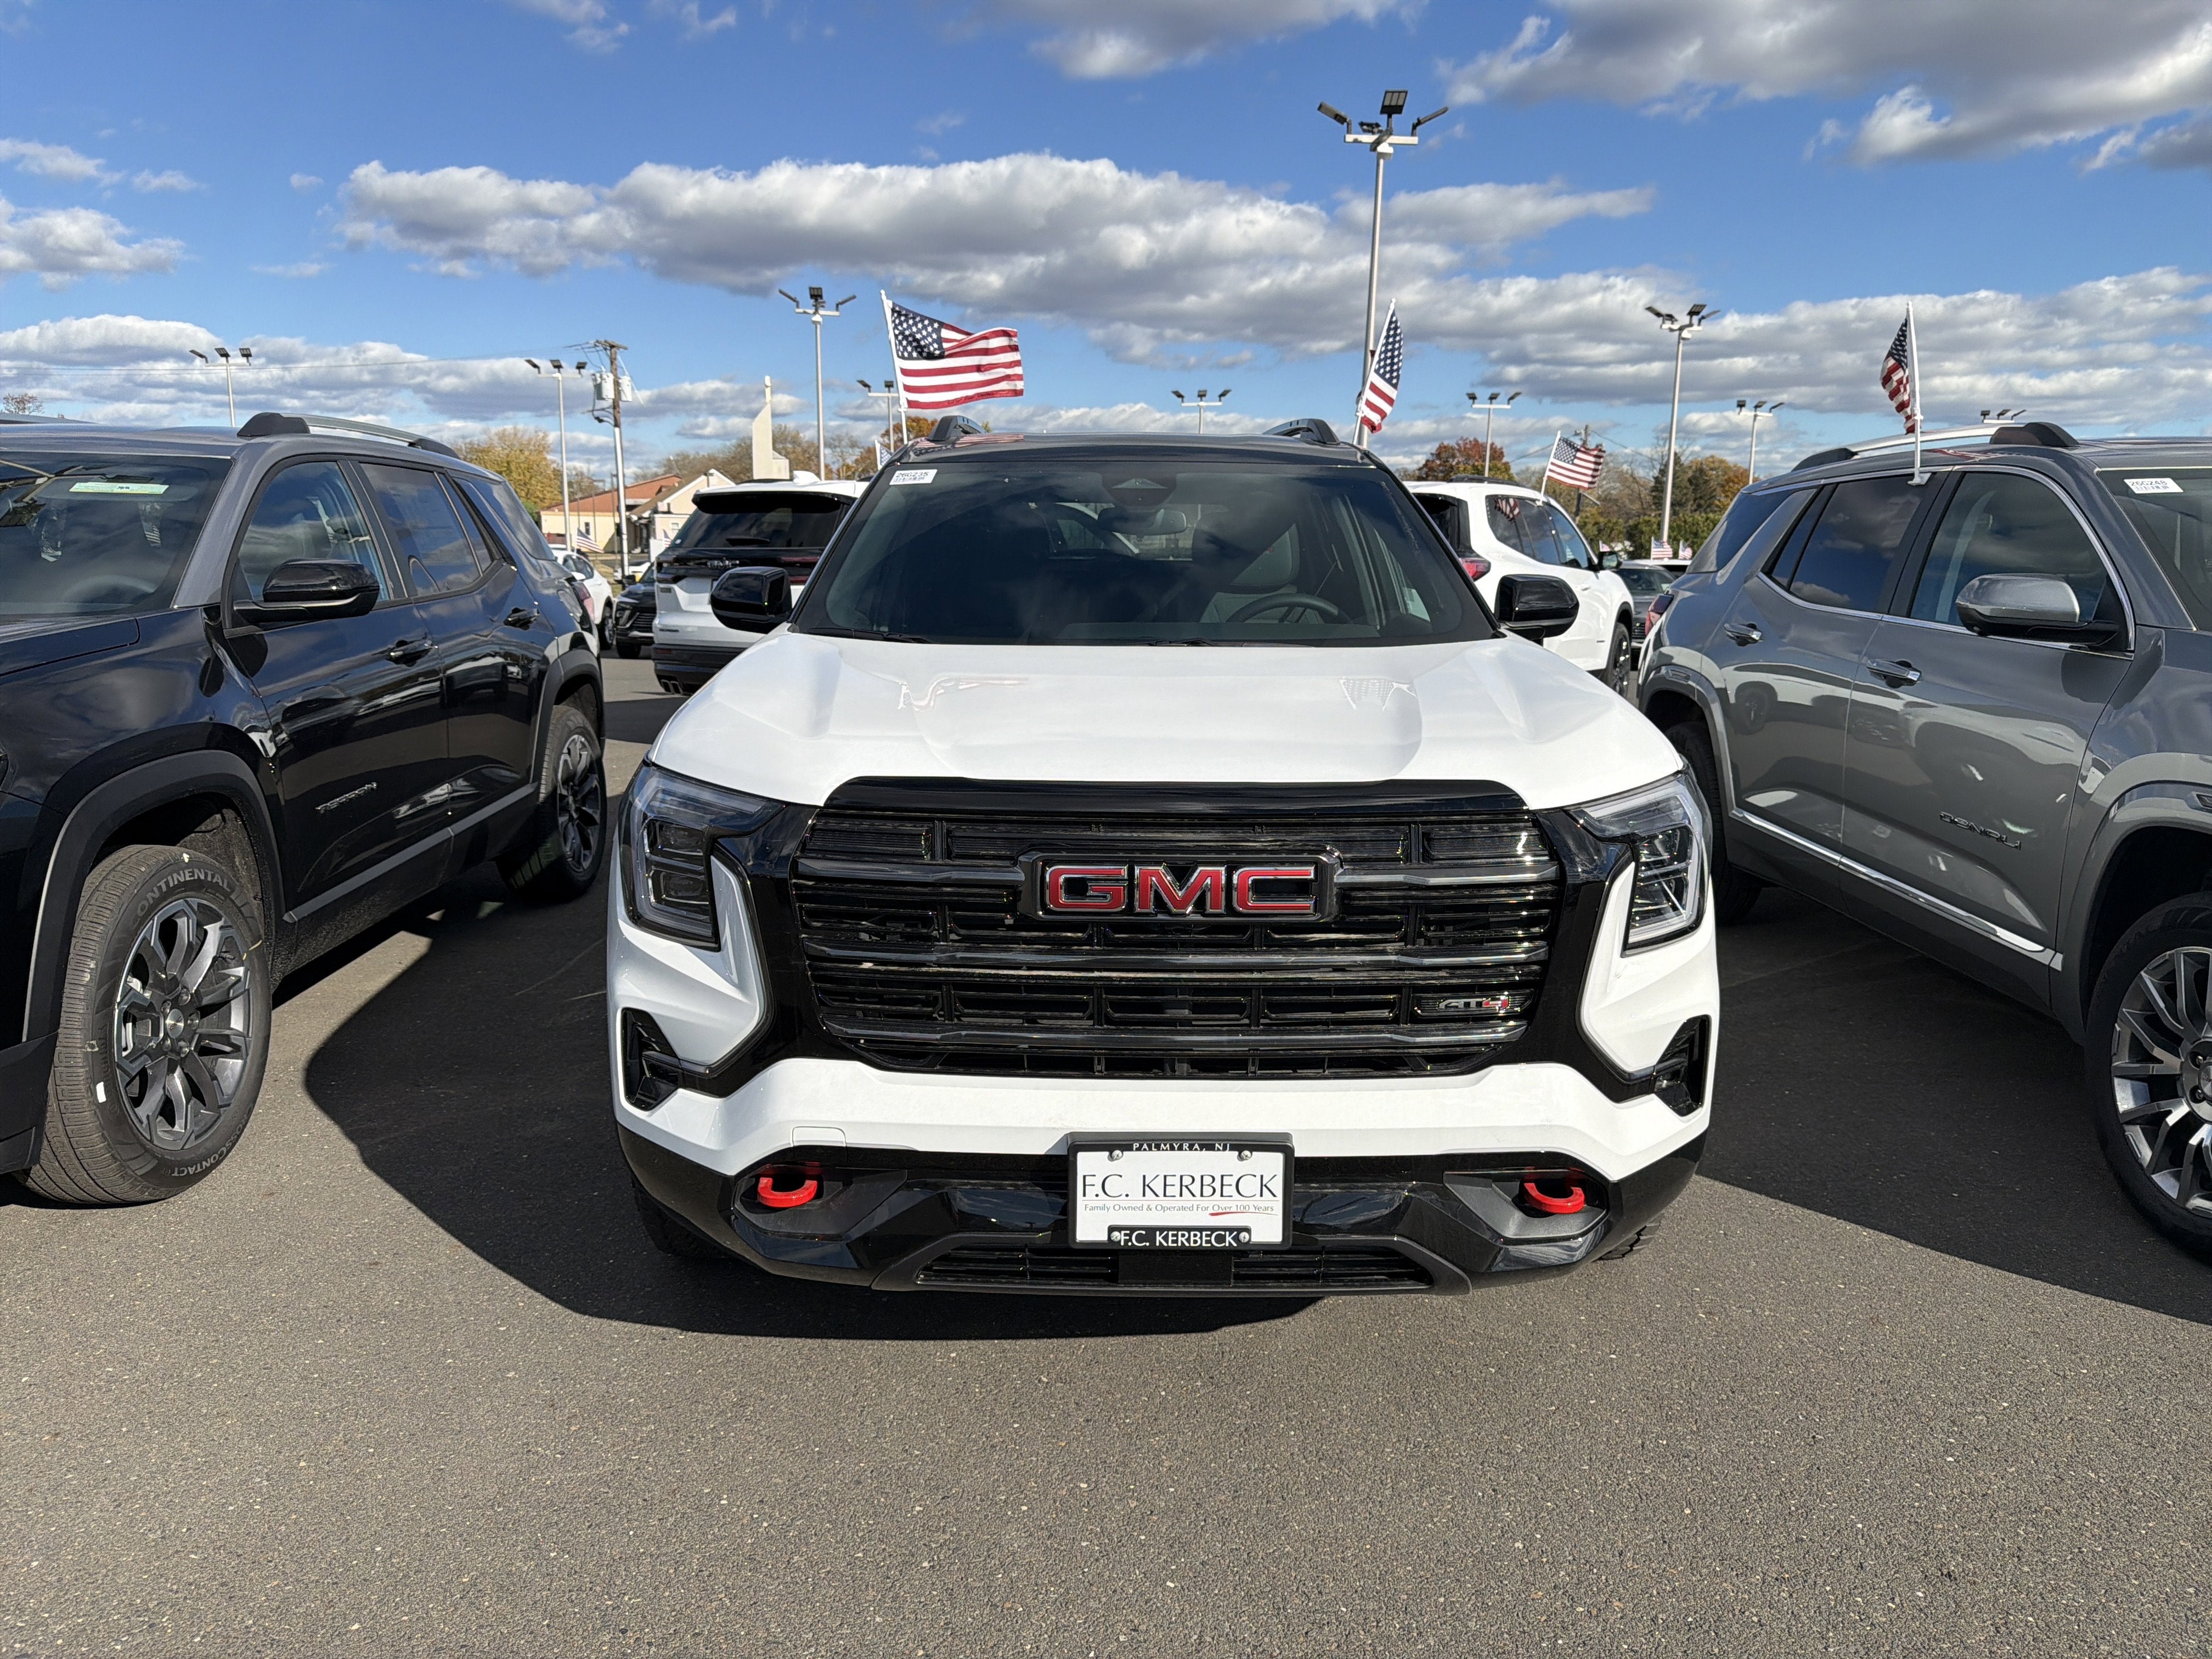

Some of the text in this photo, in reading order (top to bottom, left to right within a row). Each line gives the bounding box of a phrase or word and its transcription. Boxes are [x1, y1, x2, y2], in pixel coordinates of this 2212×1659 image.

[1939, 811, 2022, 850] DENALI
[1046, 865, 1316, 914] GMC
[1133, 1143, 1230, 1152] PALMYRA, NJ
[1082, 1174, 1278, 1198] F.C. KERBECK
[1085, 1204, 1111, 1212] Family
[1155, 1204, 1194, 1213] Operated
[1120, 1231, 1238, 1246] F.C. KERBECK
